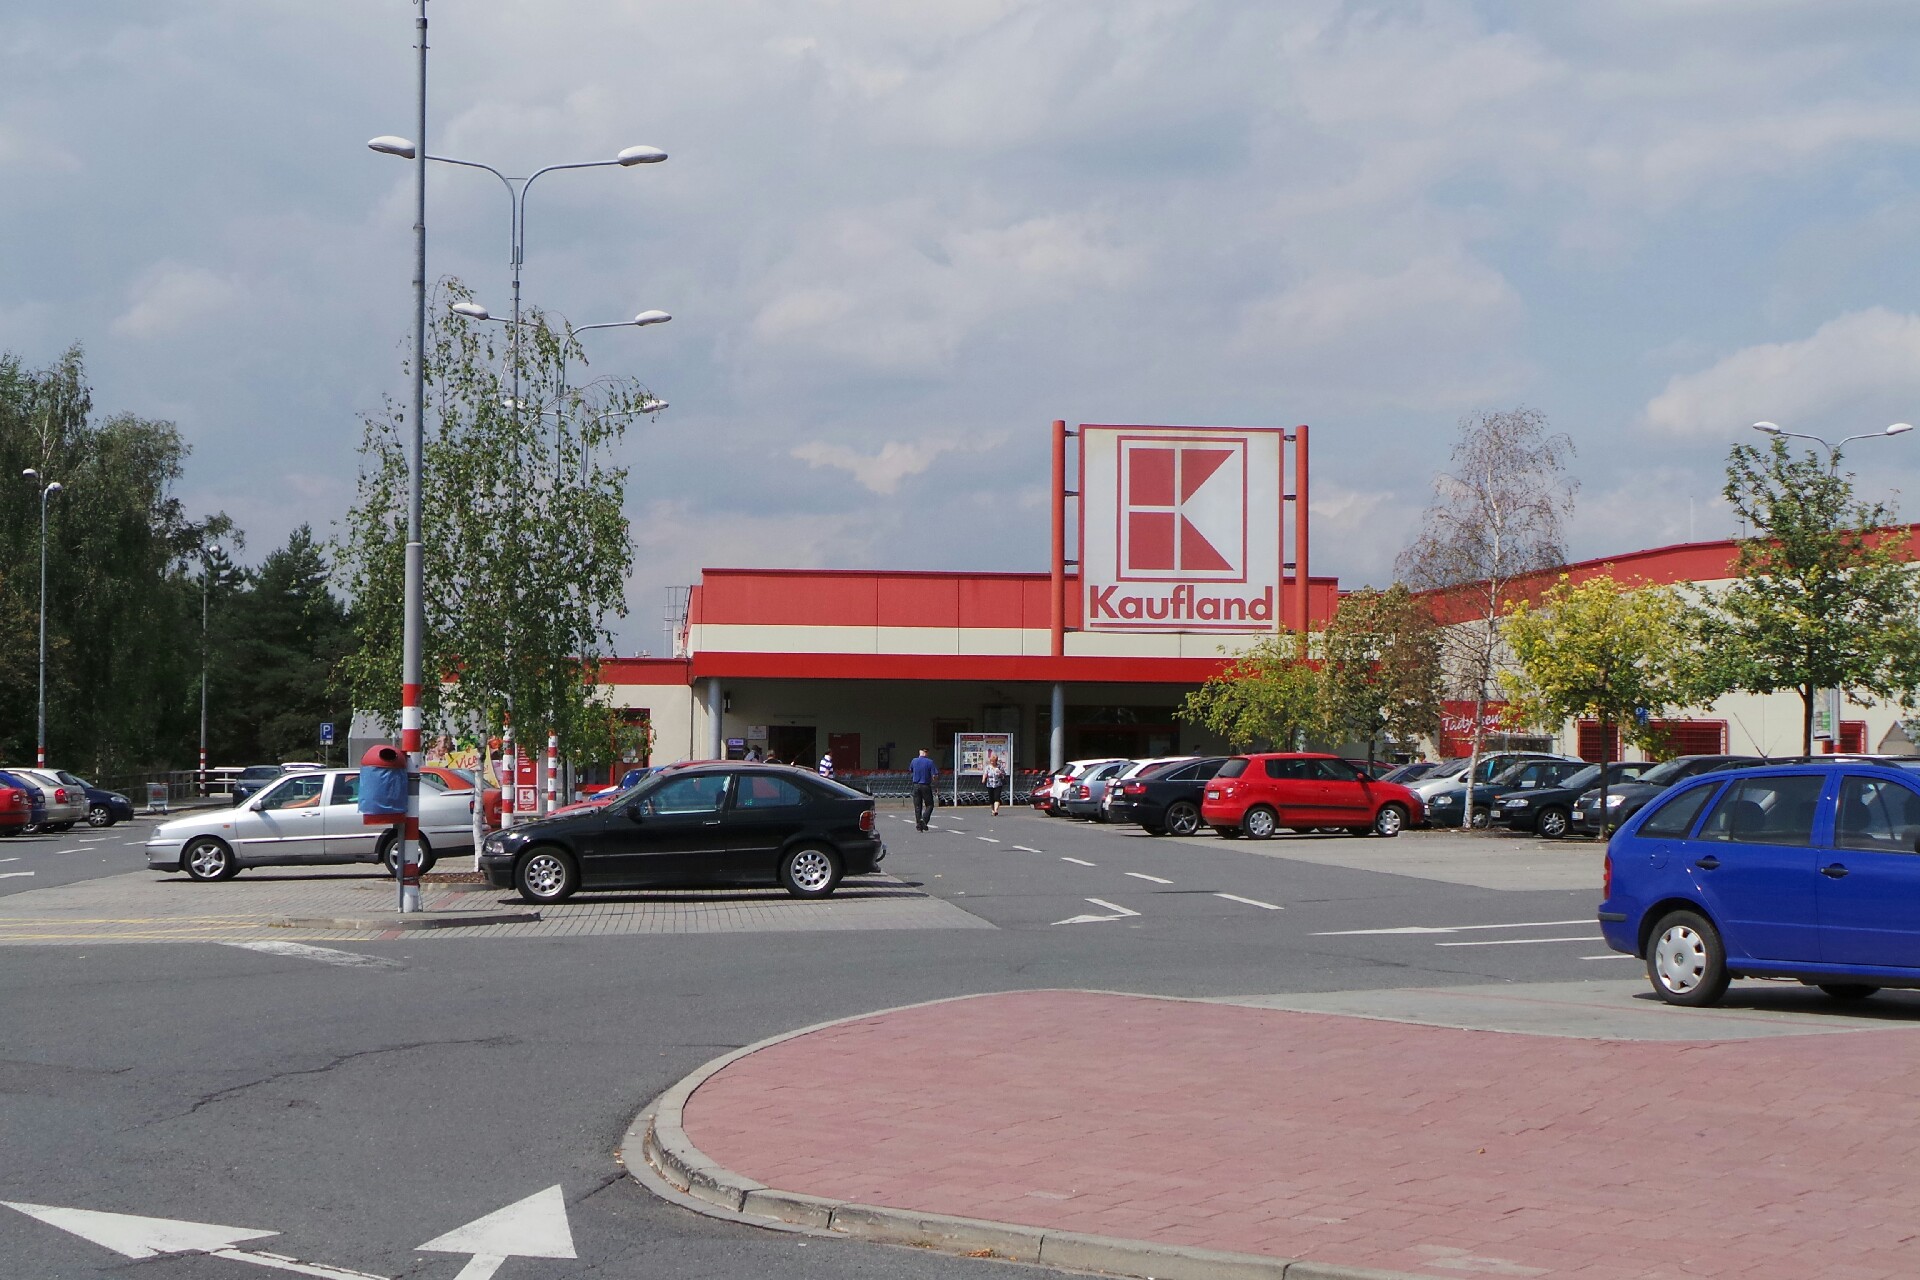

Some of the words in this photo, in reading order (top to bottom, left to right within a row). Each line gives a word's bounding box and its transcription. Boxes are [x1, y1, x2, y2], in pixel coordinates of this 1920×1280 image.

[1129, 447, 1235, 571] K
[1090, 584, 1273, 621] Kaufland
[323, 725, 331, 736] P
[1441, 714, 1473, 734] Tady
